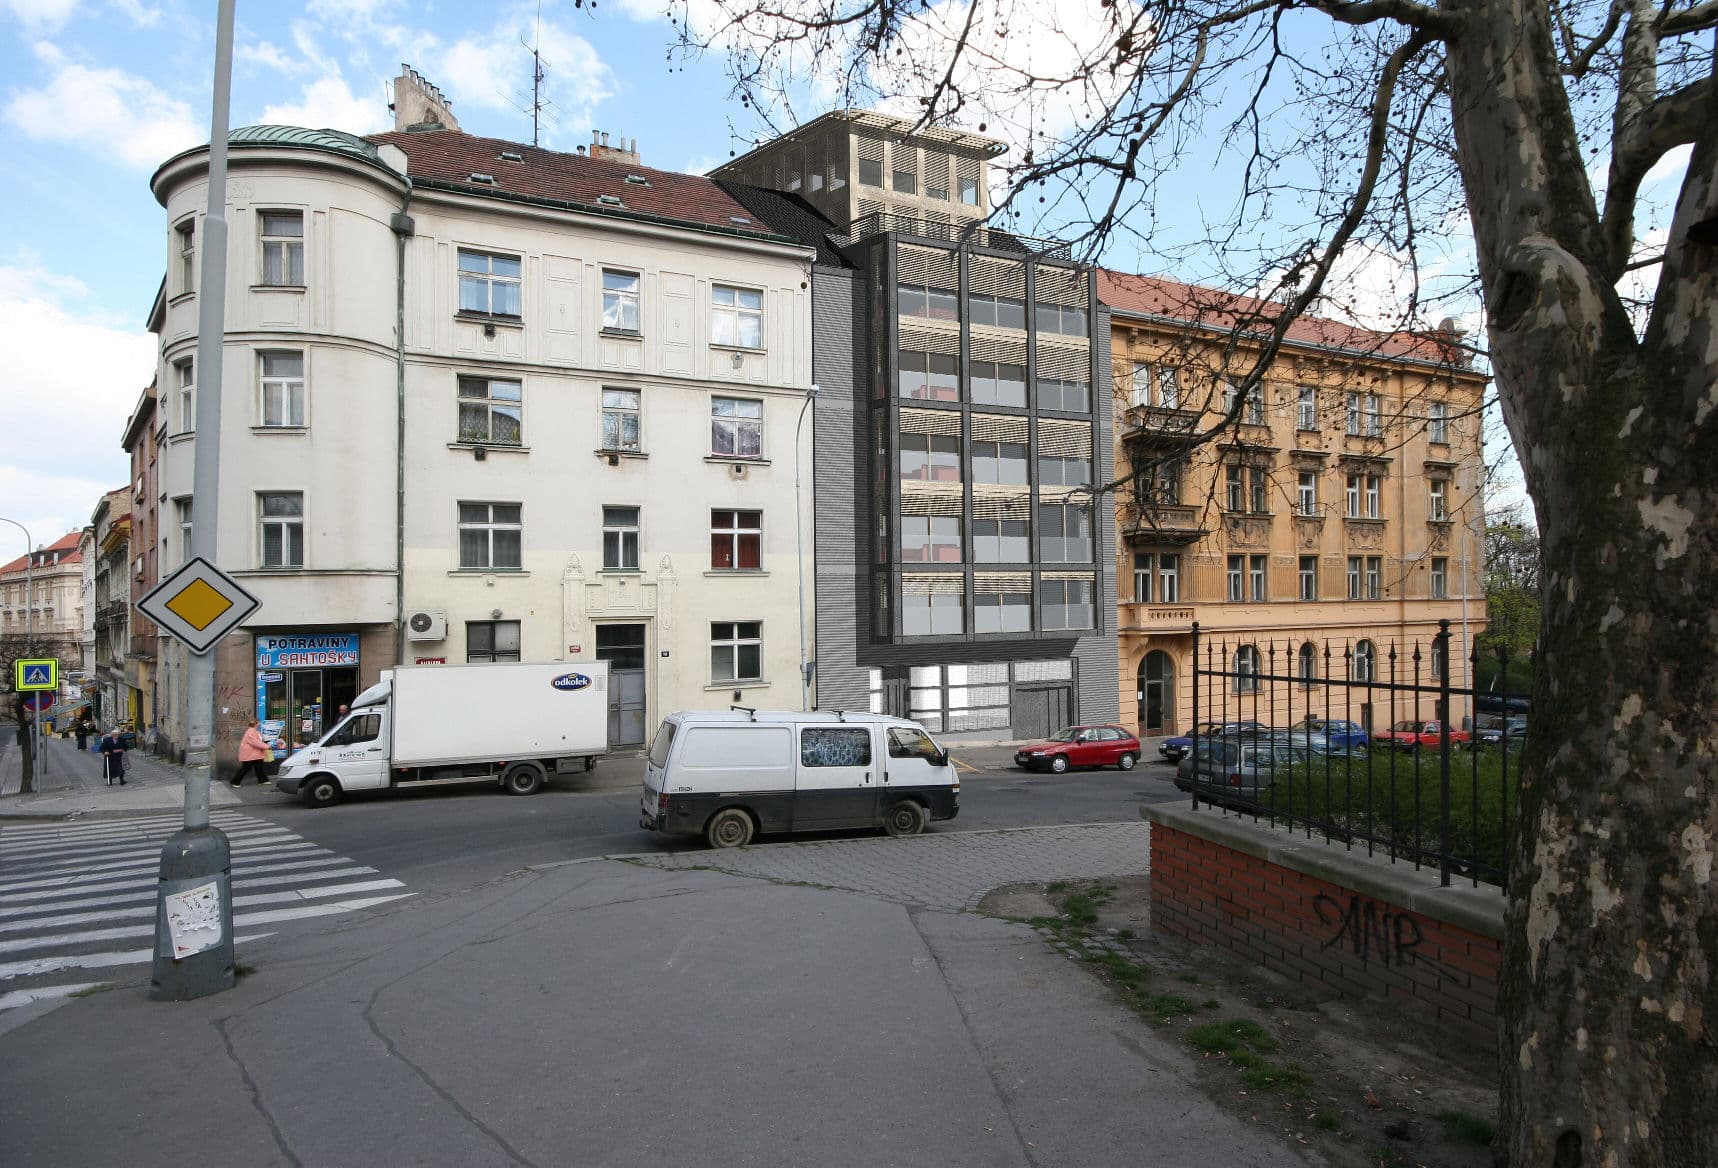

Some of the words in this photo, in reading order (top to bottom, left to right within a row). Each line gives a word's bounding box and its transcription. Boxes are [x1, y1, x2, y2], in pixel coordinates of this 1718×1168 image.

[268, 638, 349, 650] POTRAVINY
[261, 654, 271, 666] U
[554, 678, 588, 686] odkolek
